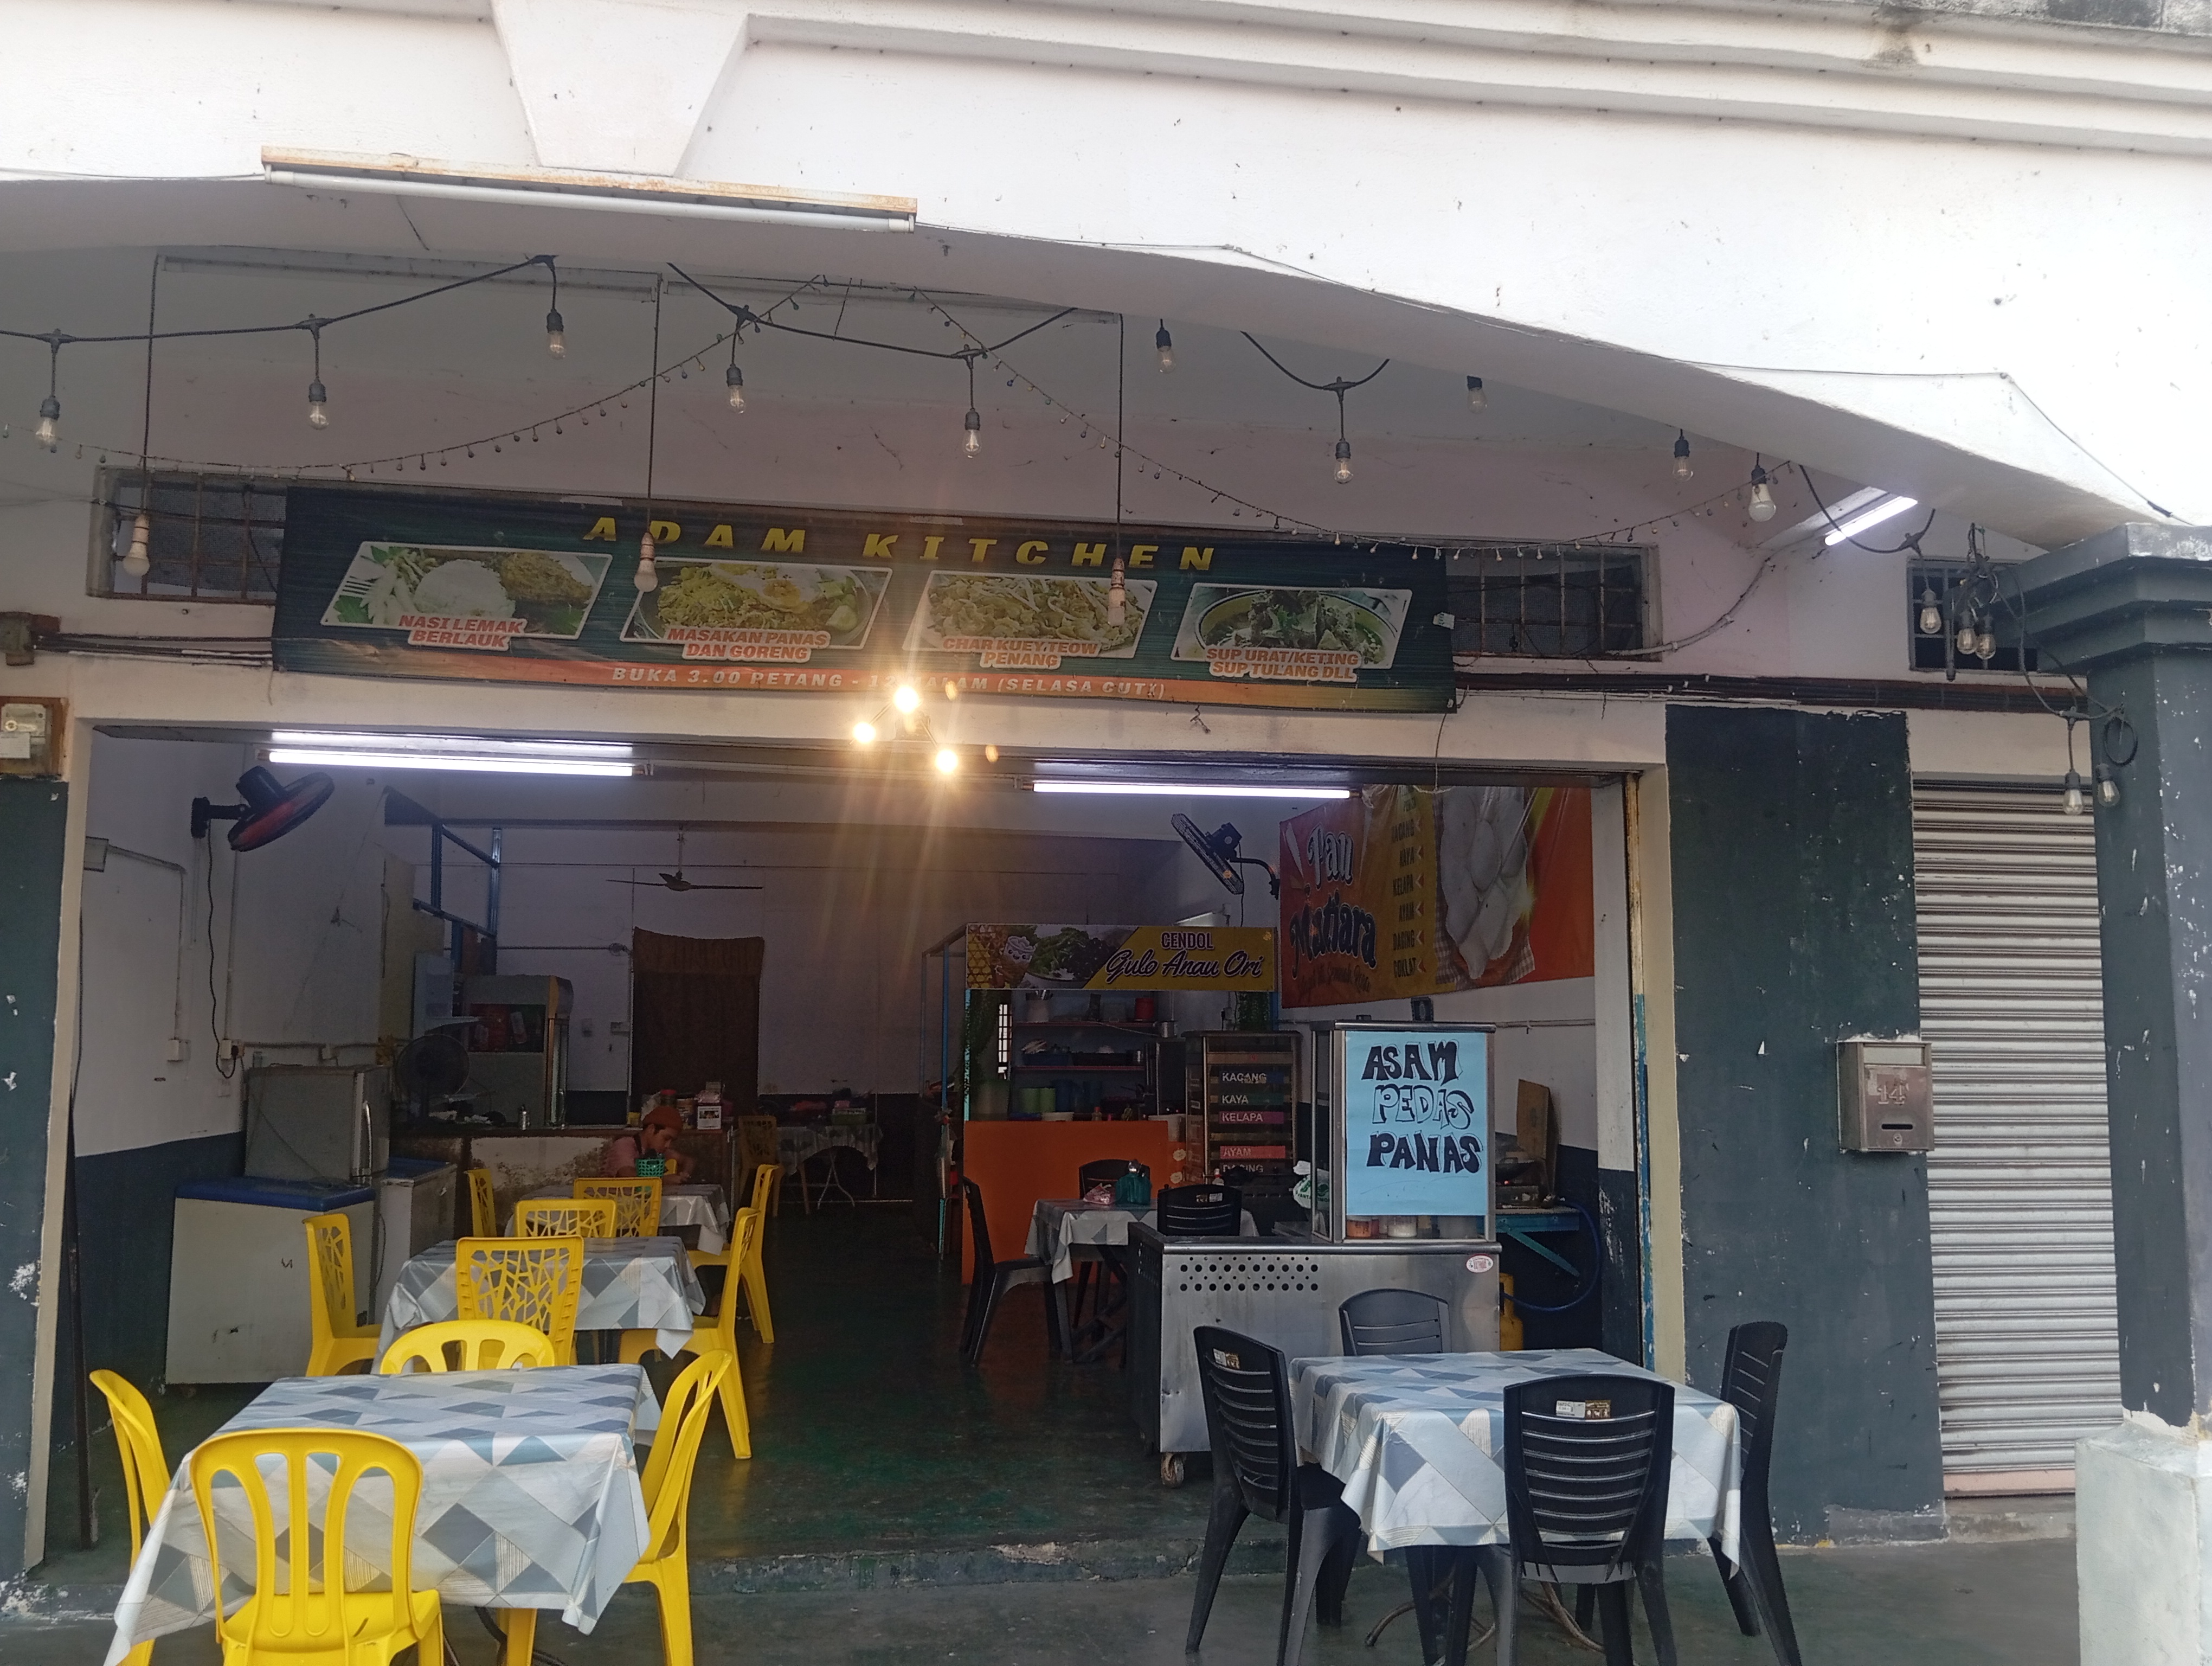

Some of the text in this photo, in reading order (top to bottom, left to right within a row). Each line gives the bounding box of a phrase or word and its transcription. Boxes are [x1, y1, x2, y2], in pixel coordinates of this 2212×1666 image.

[583, 517, 1214, 571] ADAM KITCHEN
[398, 614, 523, 633] NASI LEMAK
[411, 630, 507, 648] BERLAUK
[667, 629, 826, 645] MASAKAN PANAS
[686, 644, 808, 659] DAN GORENG
[943, 638, 1098, 654] CHAR KUEY TEOW
[983, 652, 1058, 666] PENANG
[1206, 648, 1358, 665] SUP URAT/KETING
[1212, 662, 1354, 678] SUP TULANG DLL
[613, 668, 676, 682] BUKA
[687, 670, 741, 684] 3.00
[750, 672, 843, 687] PETANG
[998, 678, 1092, 693] (SELASA
[1161, 932, 1213, 949] CENDOL
[1161, 950, 1219, 977] Anau
[1224, 950, 1264, 977] Ori
[1361, 1039, 1463, 1085] ASAM
[1222, 1095, 1249, 1104] KAYA
[1372, 1084, 1474, 1129] PEDAS
[1222, 1113, 1263, 1122] KELAPA
[1223, 1148, 1251, 1156] AYAM
[1366, 1130, 1483, 1174] PANAS
